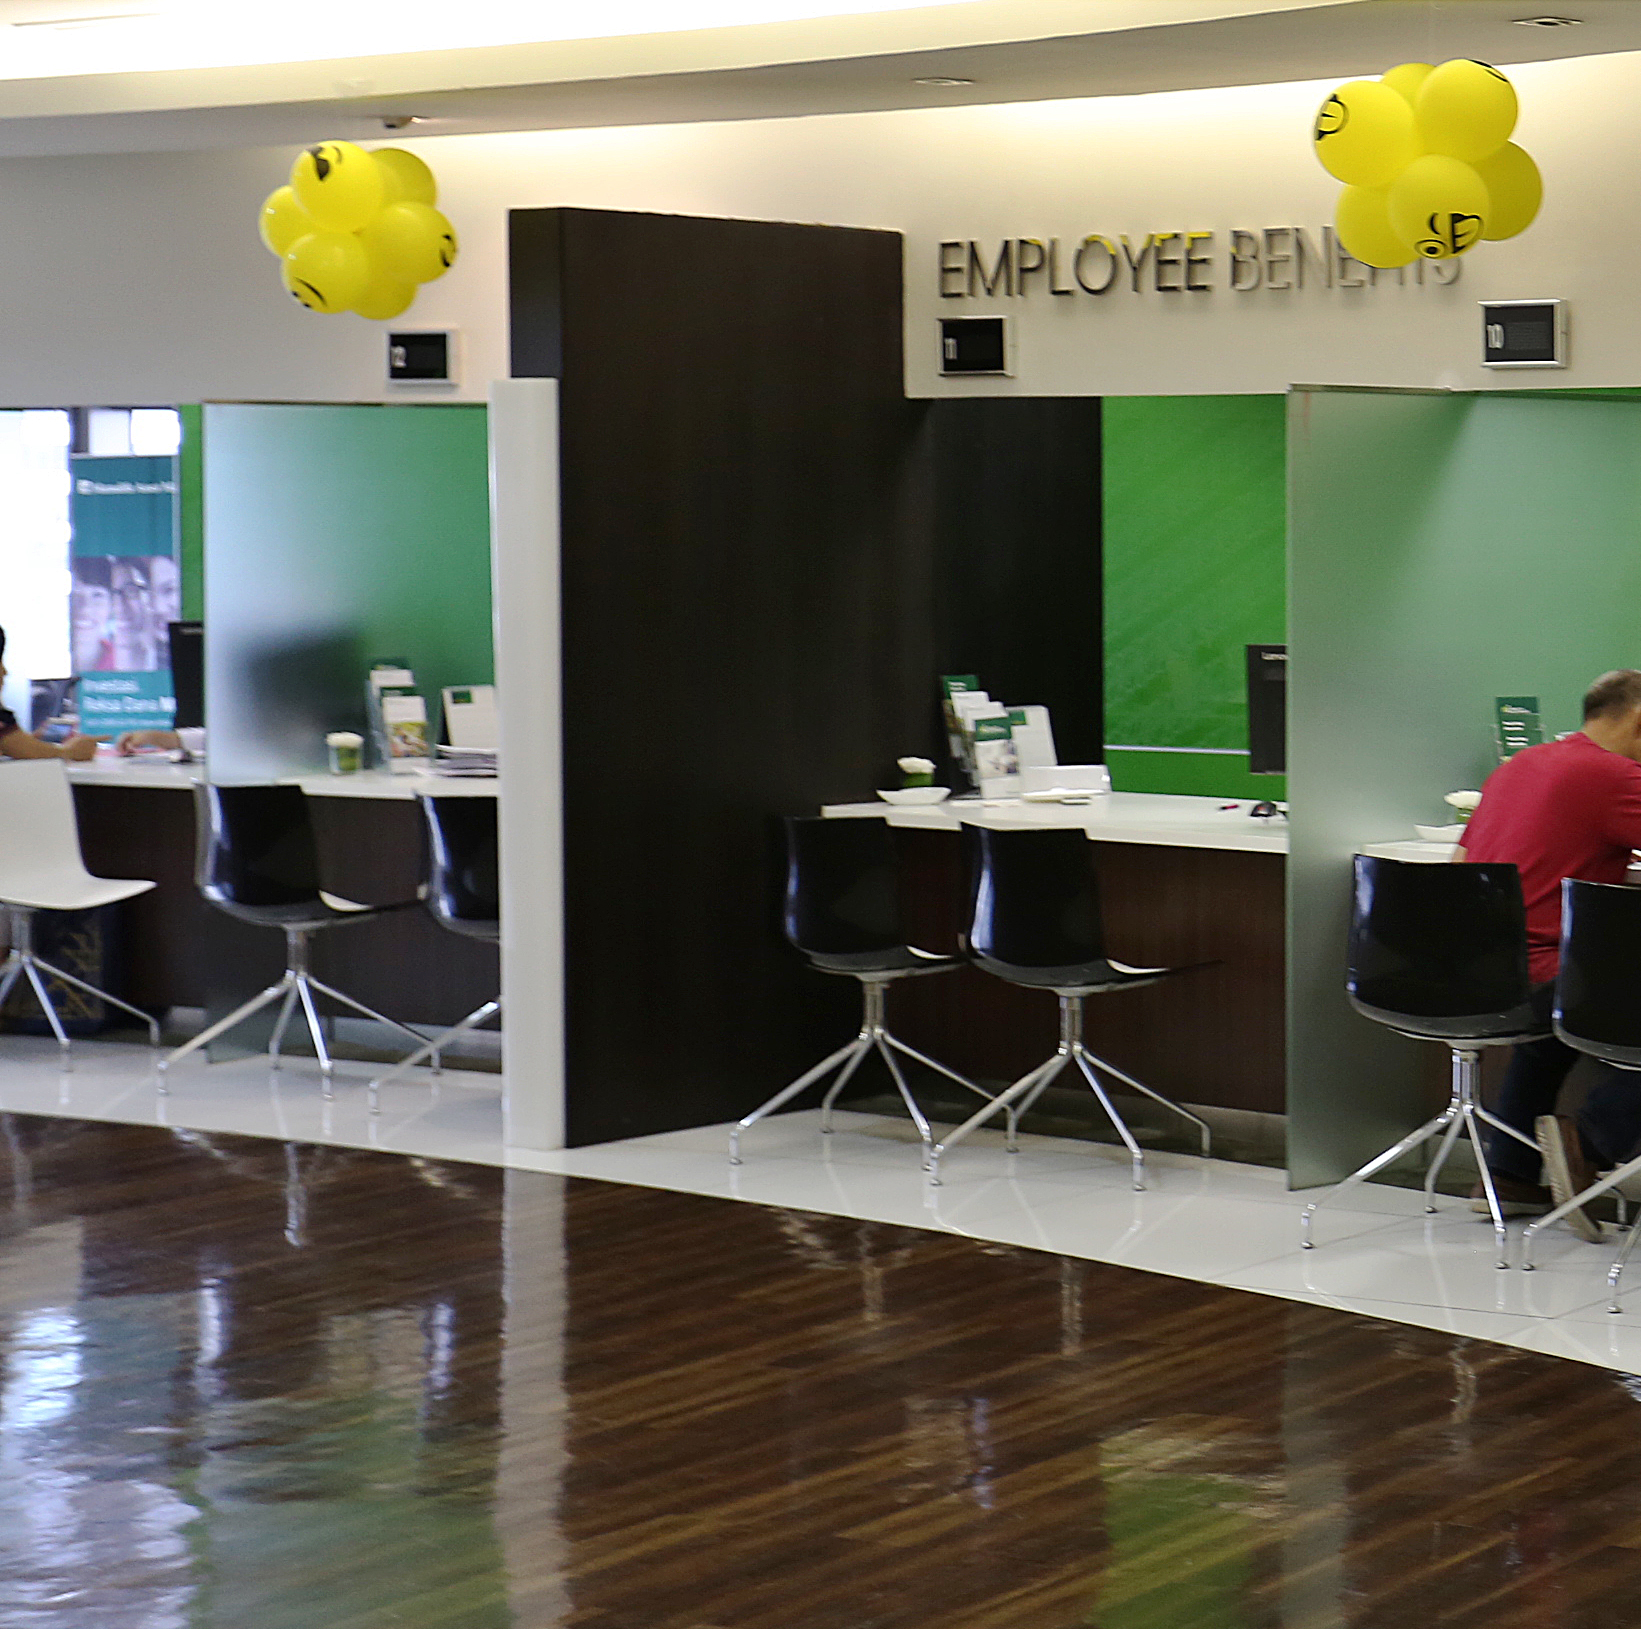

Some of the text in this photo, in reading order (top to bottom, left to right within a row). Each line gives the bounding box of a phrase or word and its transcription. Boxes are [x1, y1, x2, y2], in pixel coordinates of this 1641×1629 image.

[939, 230, 1213, 298] EMPLOYEE
[944, 338, 958, 360] 11
[1486, 323, 1505, 350] 10
